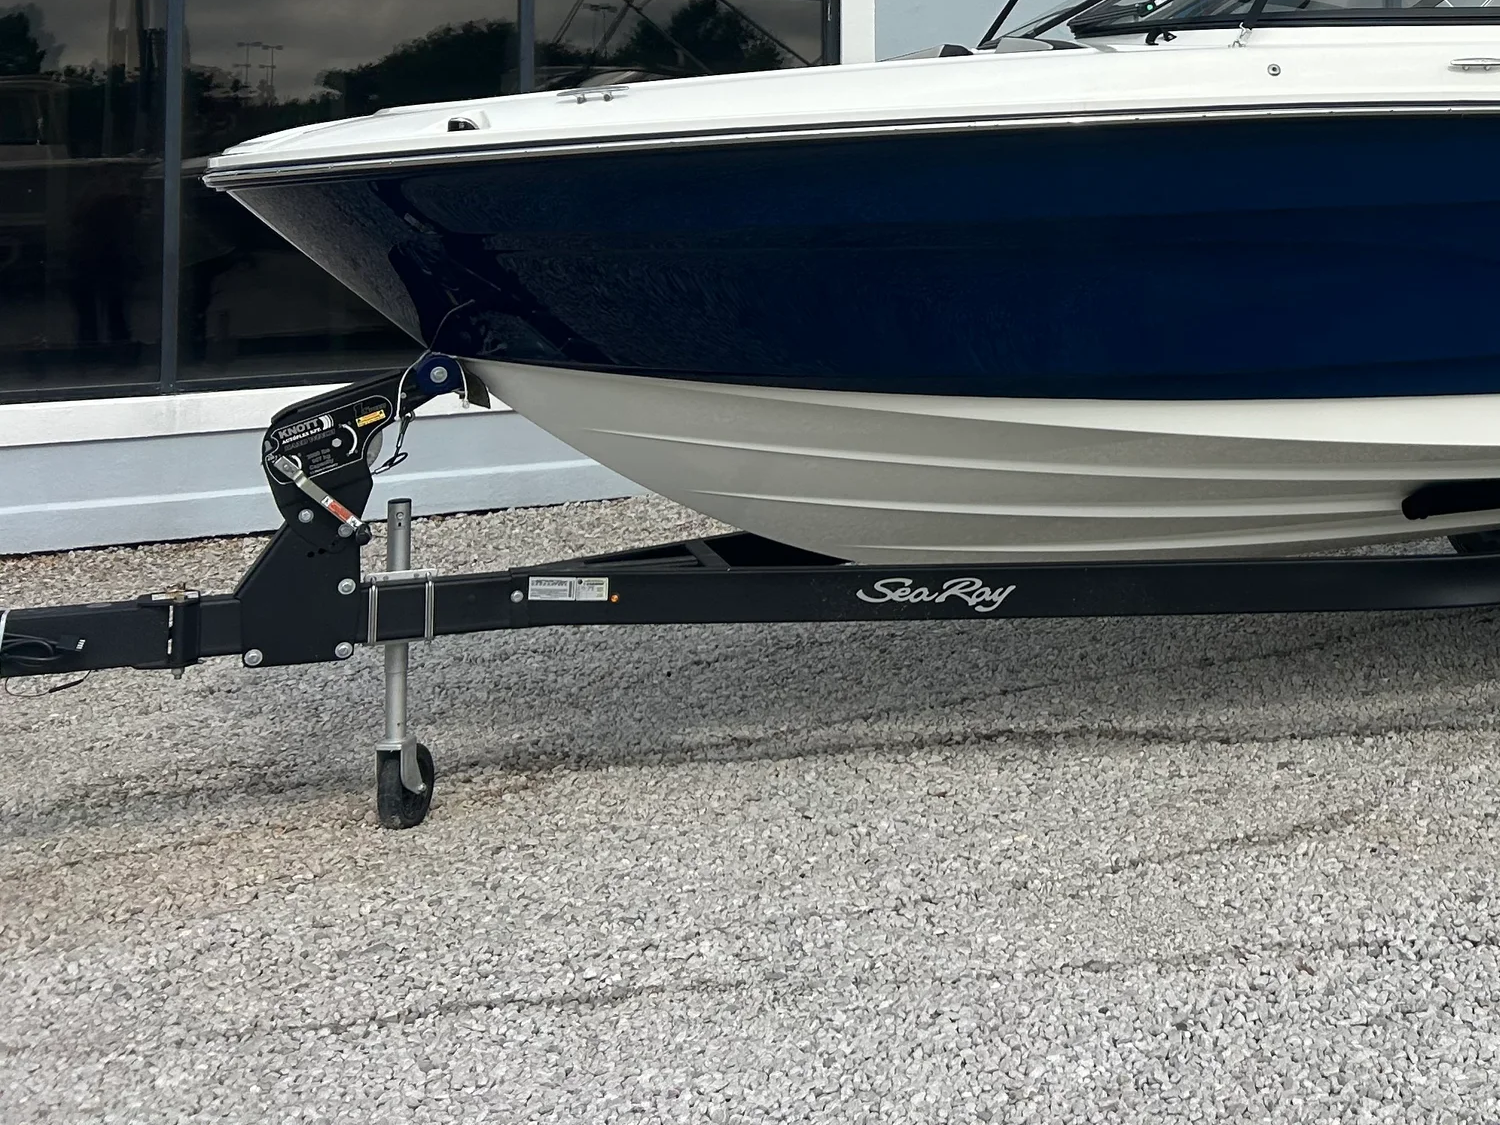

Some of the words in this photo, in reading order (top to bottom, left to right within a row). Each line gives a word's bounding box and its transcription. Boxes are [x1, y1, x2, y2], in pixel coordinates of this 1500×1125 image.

[278, 418, 319, 439] KNOTT
[855, 577, 939, 604] Sea
[934, 577, 1017, 613] Ray
